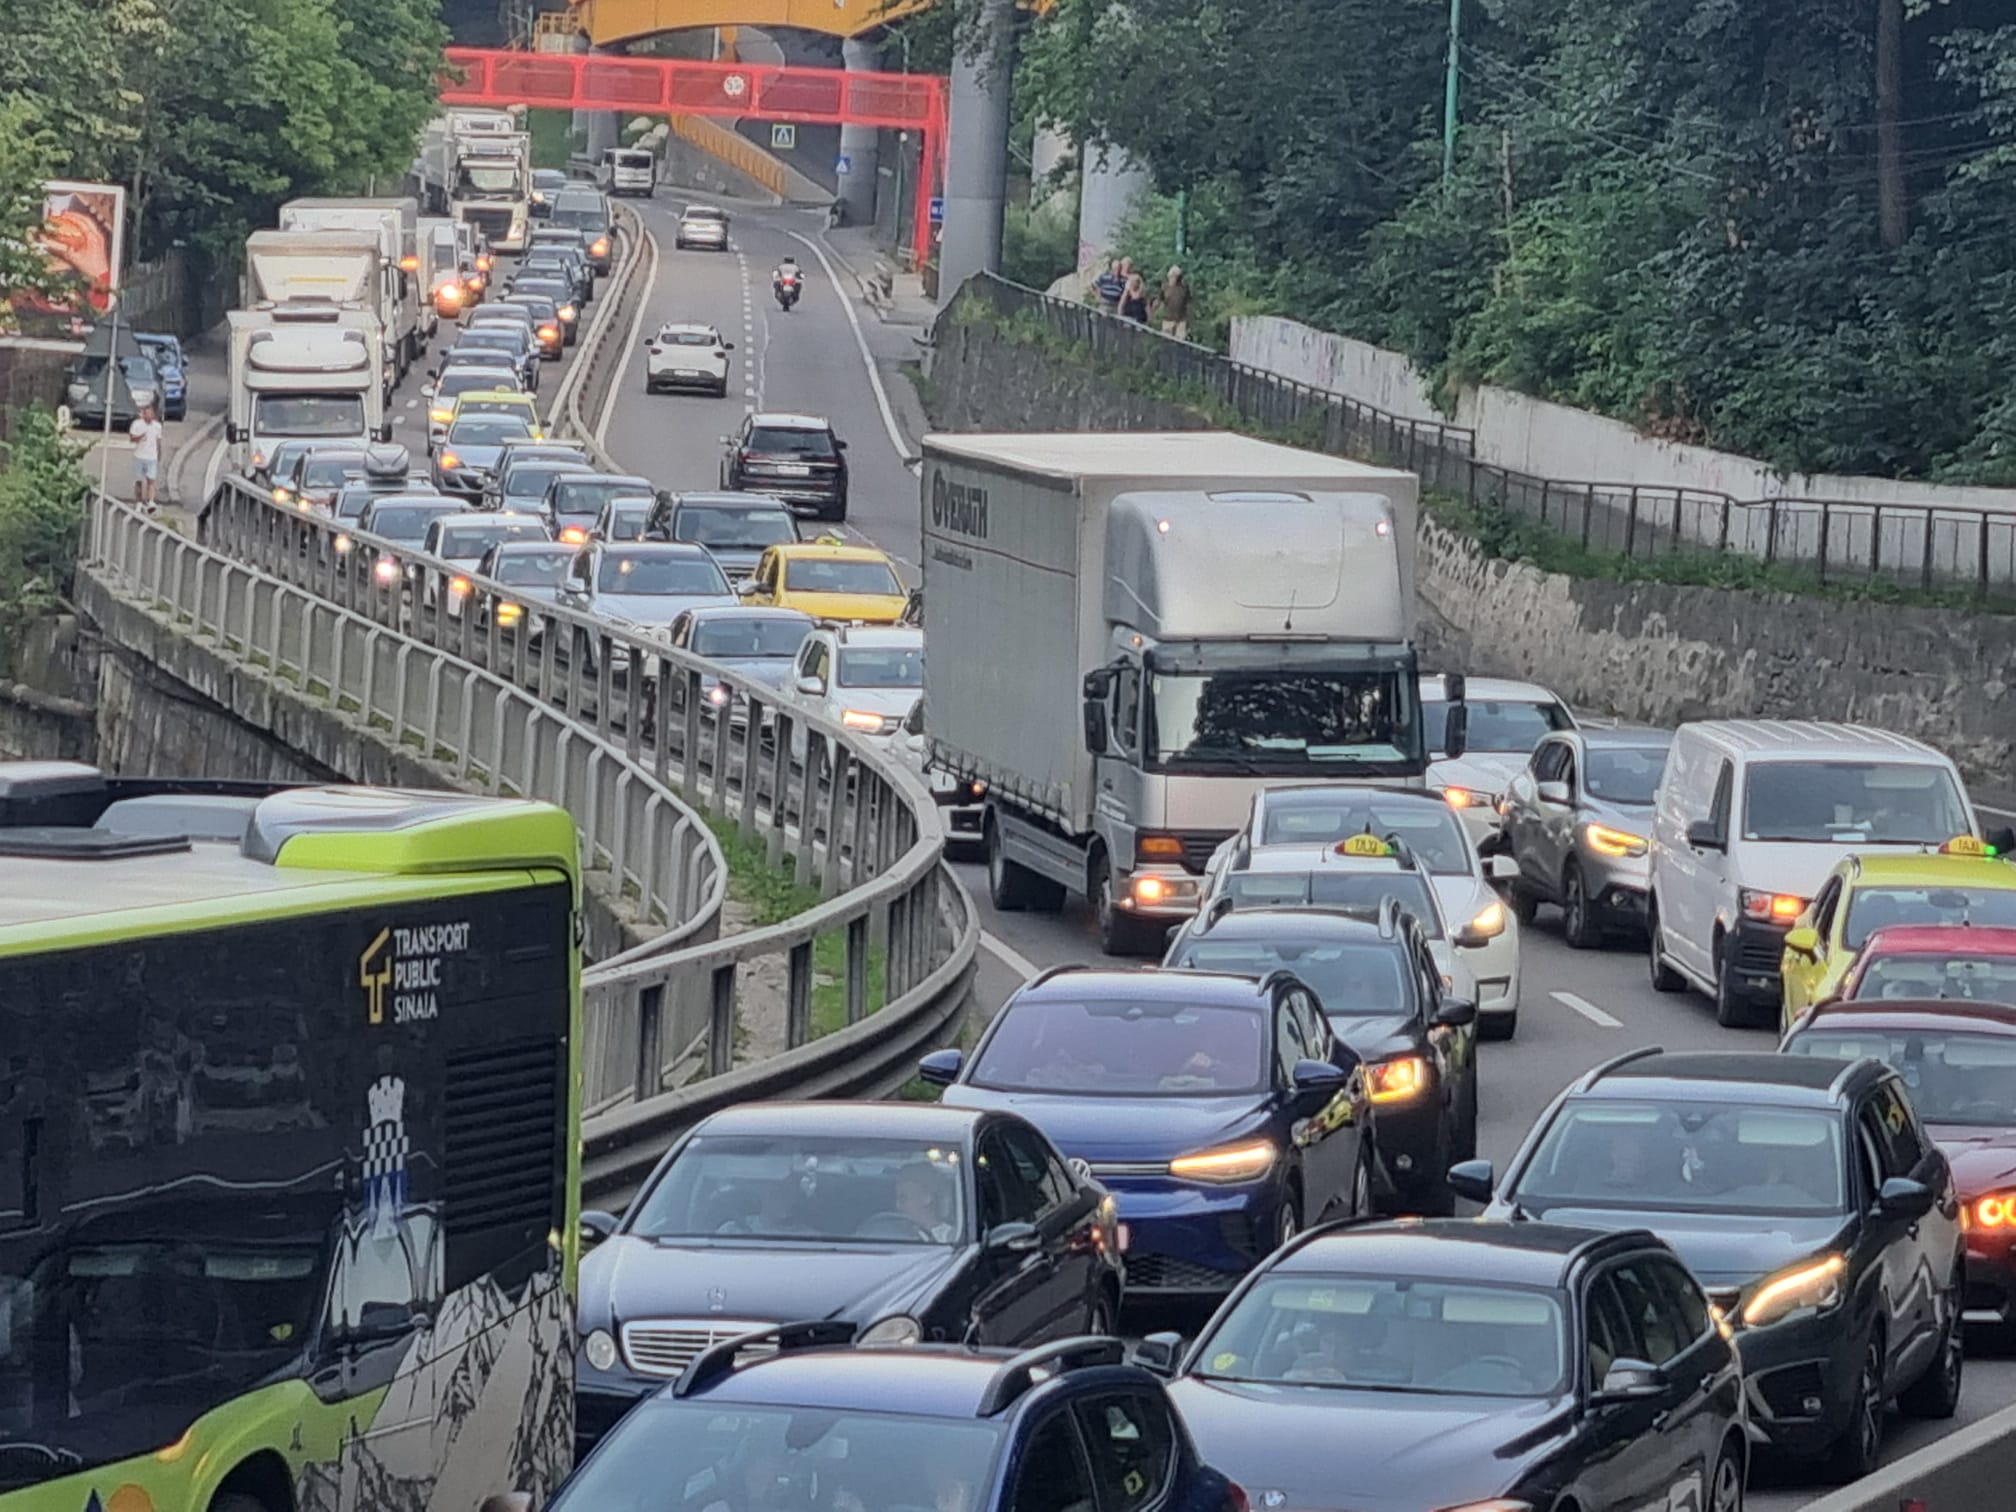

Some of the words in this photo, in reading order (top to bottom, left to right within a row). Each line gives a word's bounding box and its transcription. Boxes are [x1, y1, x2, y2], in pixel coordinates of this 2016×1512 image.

[394, 922, 470, 956] TRANSPORT
[394, 958, 441, 990] PUBLIC
[394, 993, 438, 1024] SINAIA
